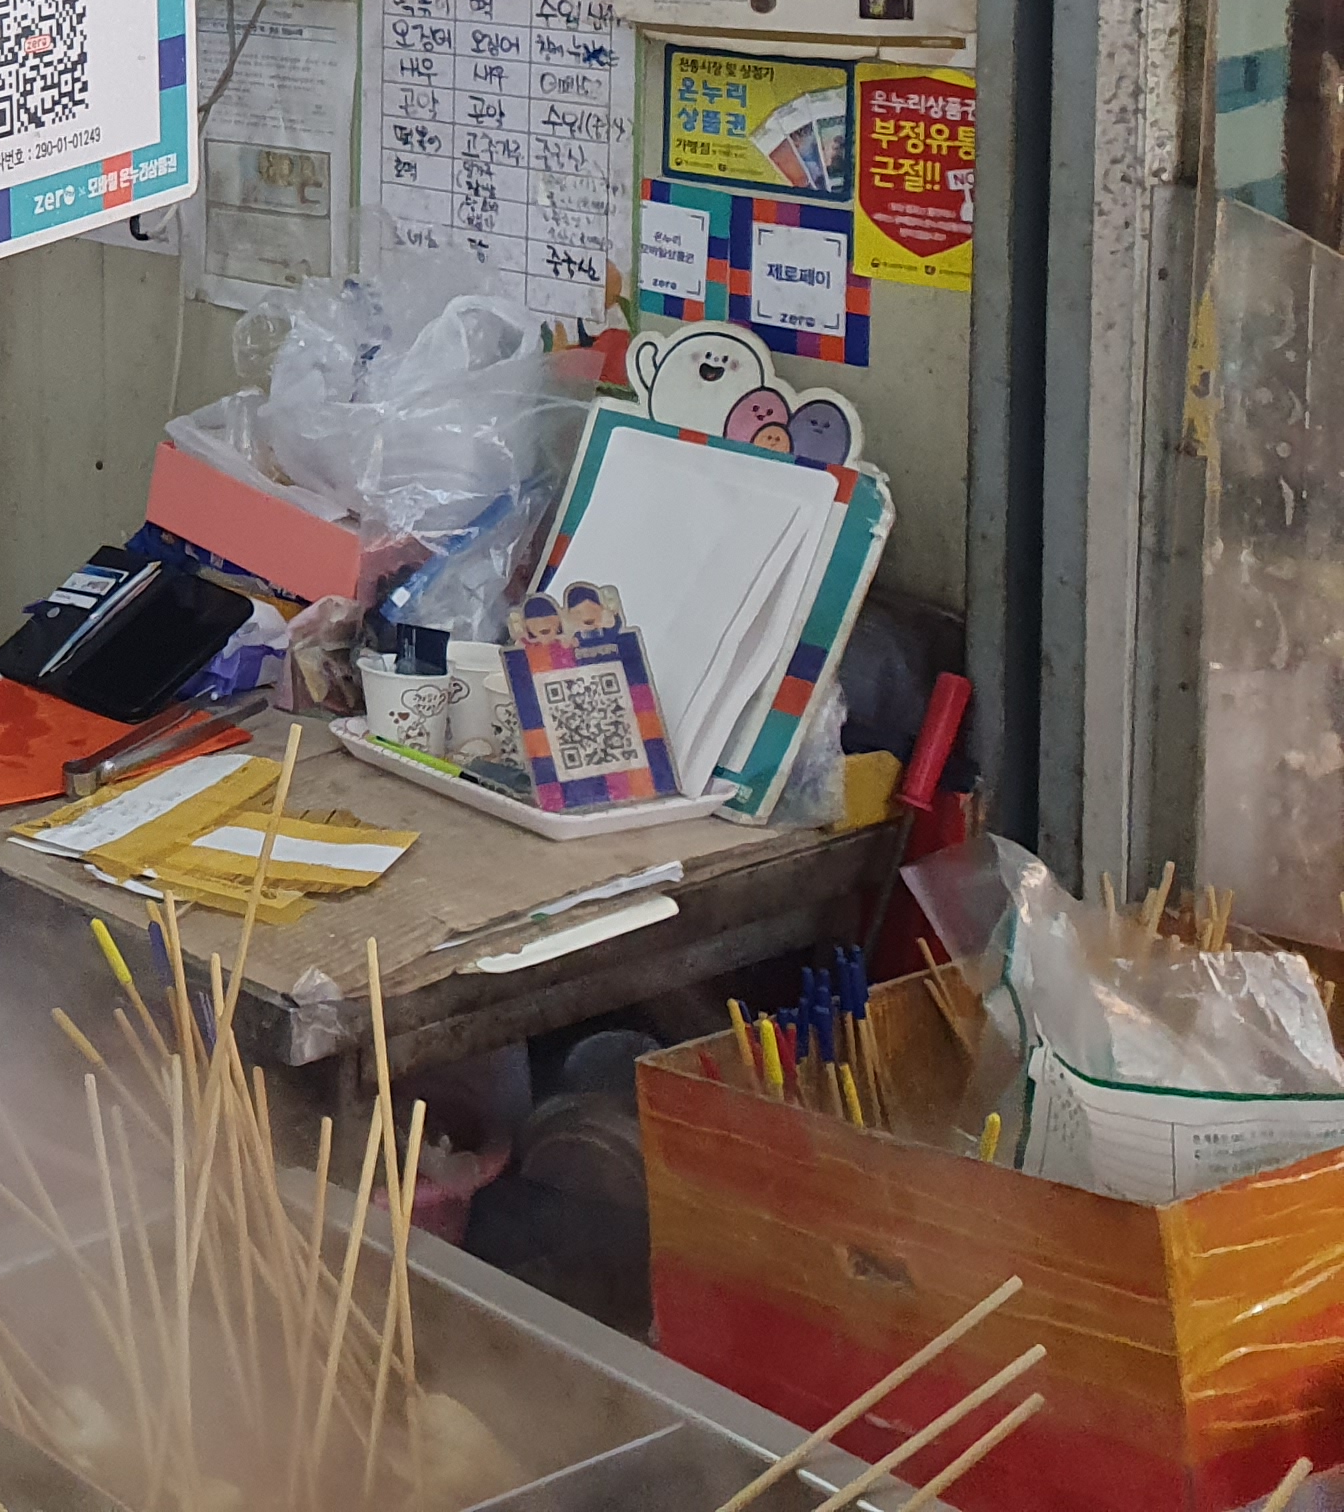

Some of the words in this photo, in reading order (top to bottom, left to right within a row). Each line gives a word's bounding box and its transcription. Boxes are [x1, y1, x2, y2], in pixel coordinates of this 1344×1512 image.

[678, 56, 722, 76] 전통시장
[726, 62, 737, 77] 및
[740, 62, 775, 81] 상점가
[678, 77, 748, 108] 온누리
[677, 108, 746, 139] 상품권
[35, 131, 101, 160] 290-01-01249
[675, 138, 710, 157] 가맹점
[870, 118, 976, 161] 부정유통
[869, 156, 941, 192] 근절!!
[34, 185, 76, 214] zero
[652, 278, 677, 290] zero
[766, 261, 831, 289] 제로페이
[779, 312, 815, 328] zero
